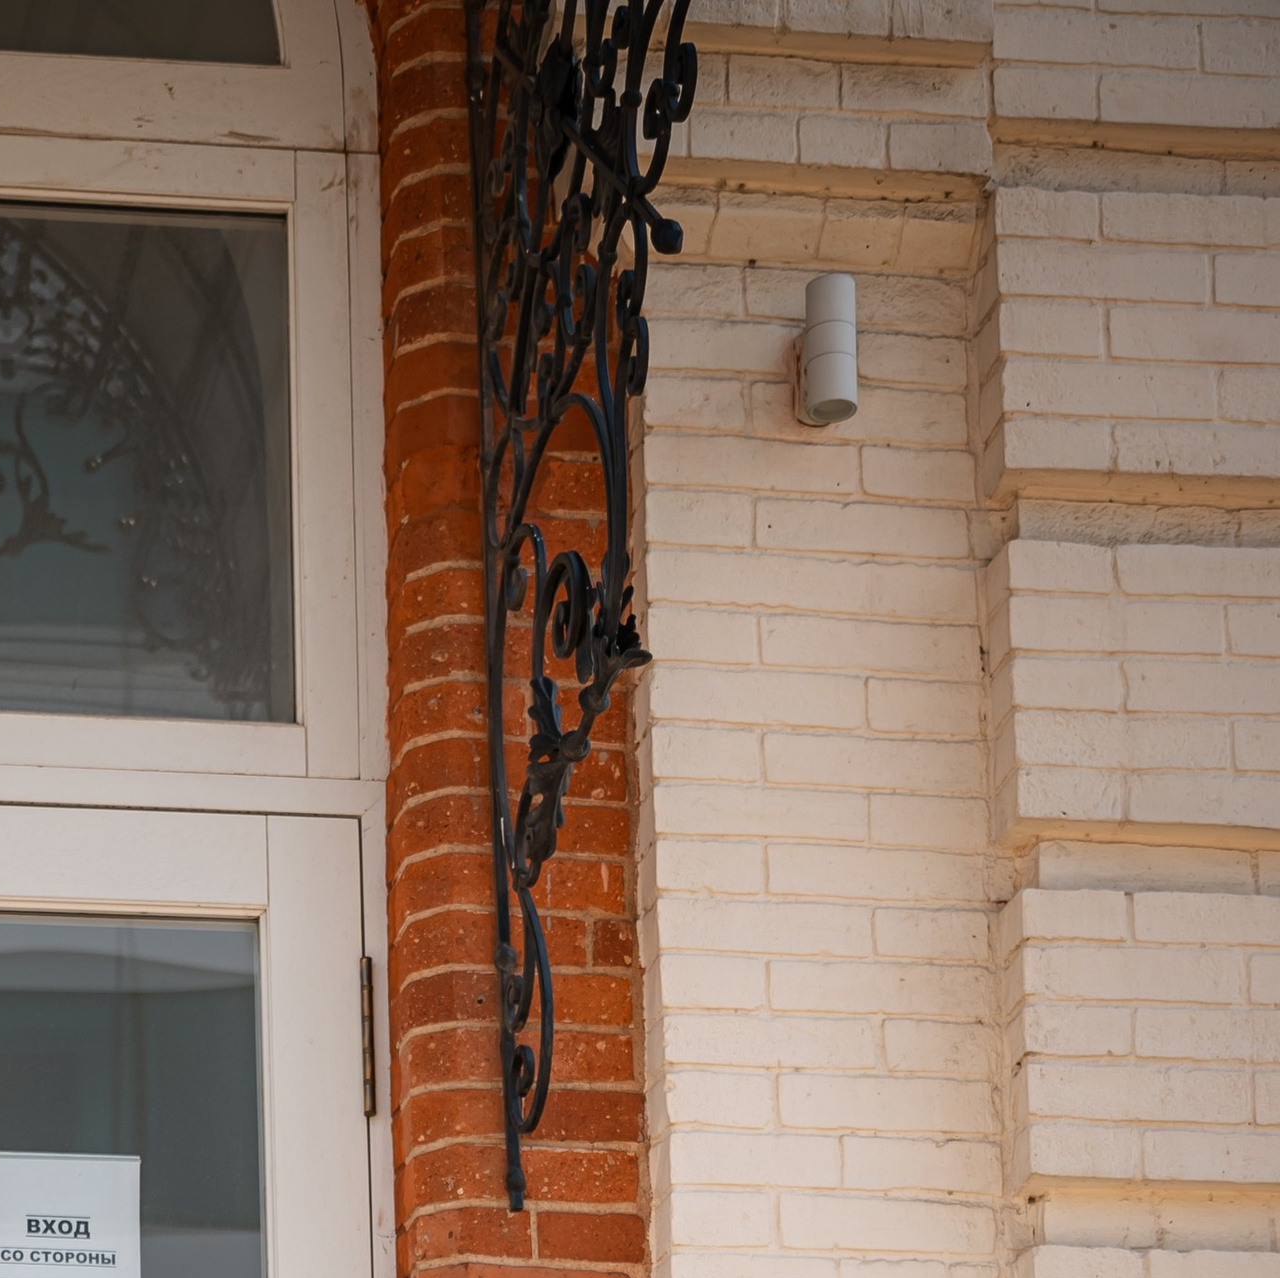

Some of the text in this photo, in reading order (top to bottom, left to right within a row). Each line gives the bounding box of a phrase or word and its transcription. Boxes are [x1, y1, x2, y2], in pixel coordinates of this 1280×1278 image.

[27, 1218, 90, 1239] ВХОД
[0, 1249, 116, 1265] СО СТОРОНЫ
